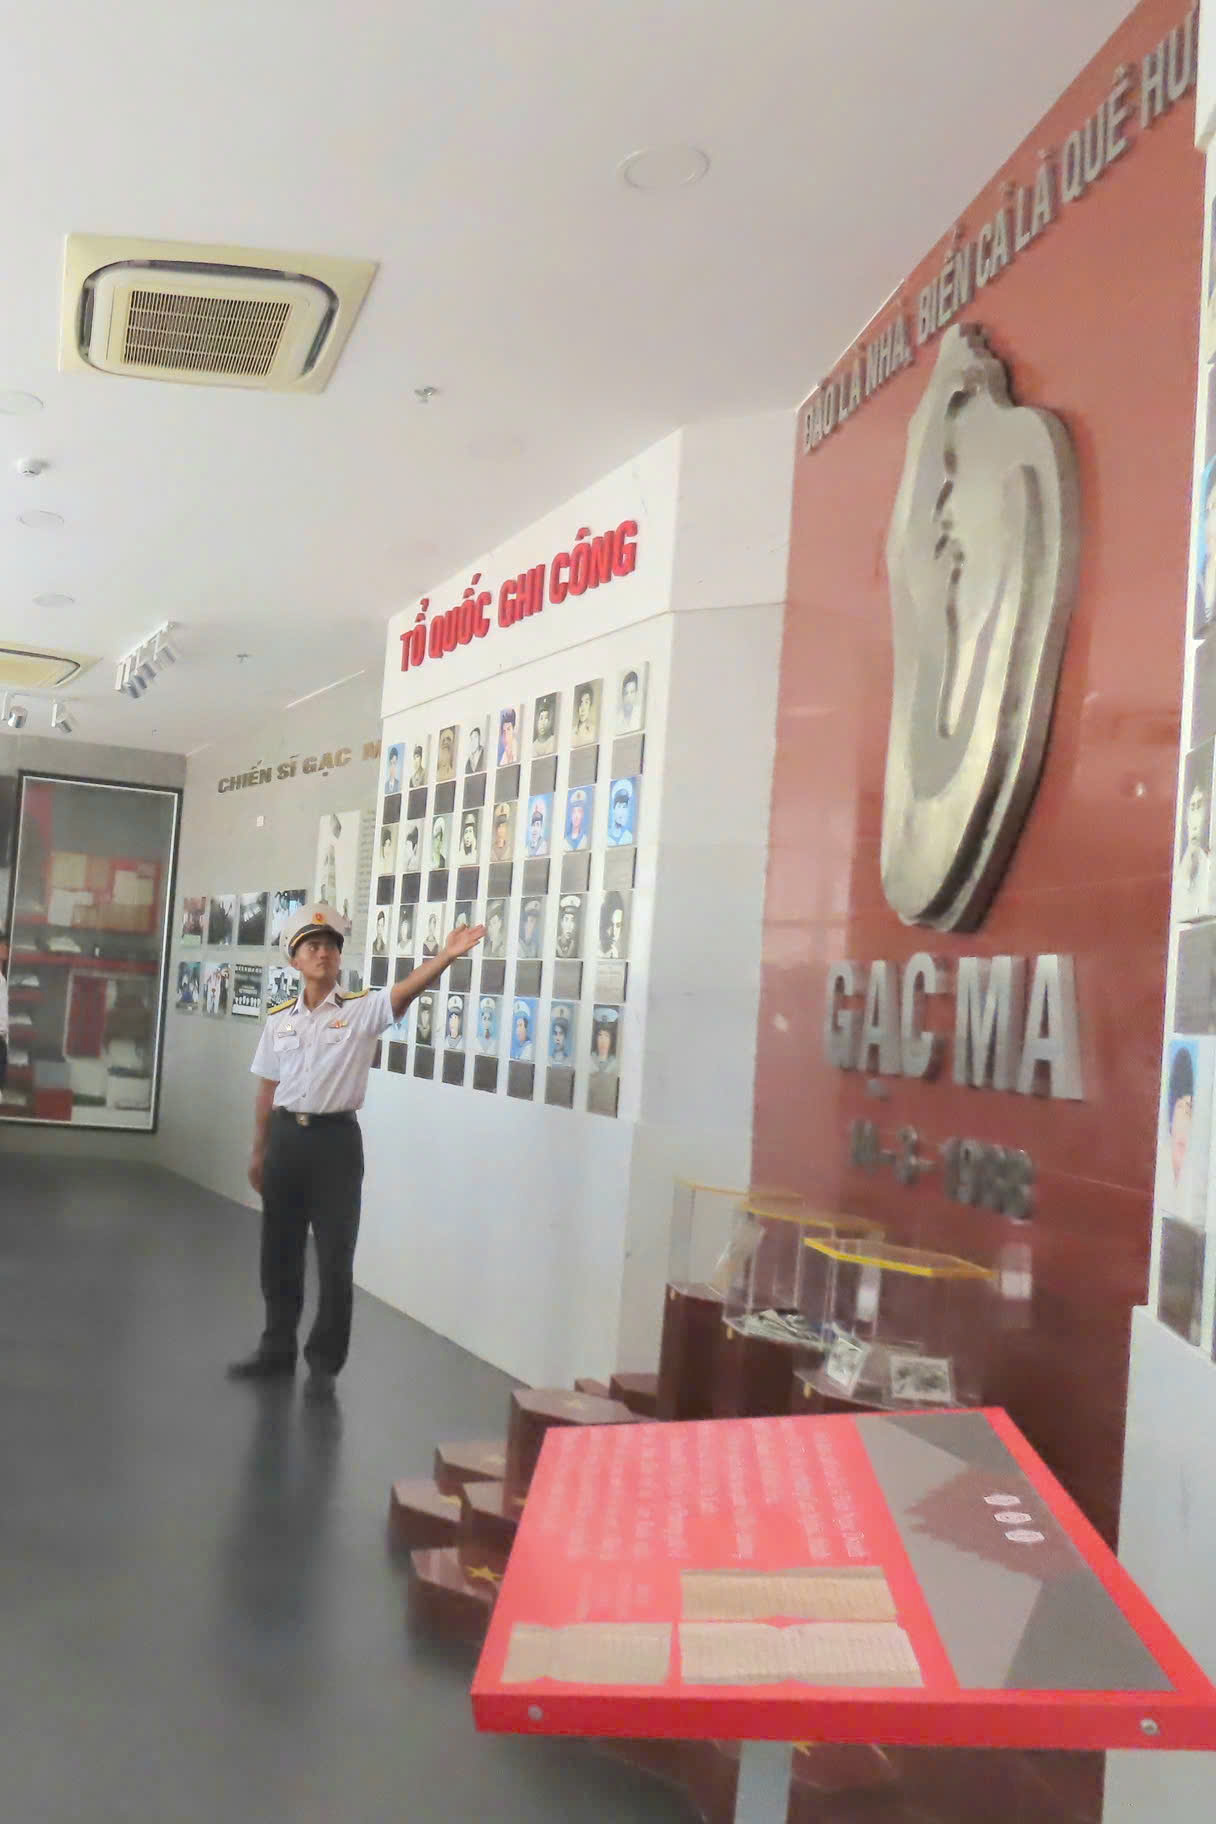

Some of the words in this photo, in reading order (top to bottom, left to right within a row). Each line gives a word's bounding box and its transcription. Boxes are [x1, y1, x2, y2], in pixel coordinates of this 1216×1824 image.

[1014, 148, 1053, 253] LÀ
[1060, 63, 1132, 204] QUÊ
[400, 598, 430, 672] TỔ
[428, 572, 492, 659] QUỐC
[497, 563, 546, 628] GHI
[549, 520, 639, 604] CÔNG
[217, 759, 272, 794] CHIẾN
[302, 747, 352, 777] GẠC
[825, 952, 944, 1100] GẠC
[953, 953, 1084, 1102] MA
